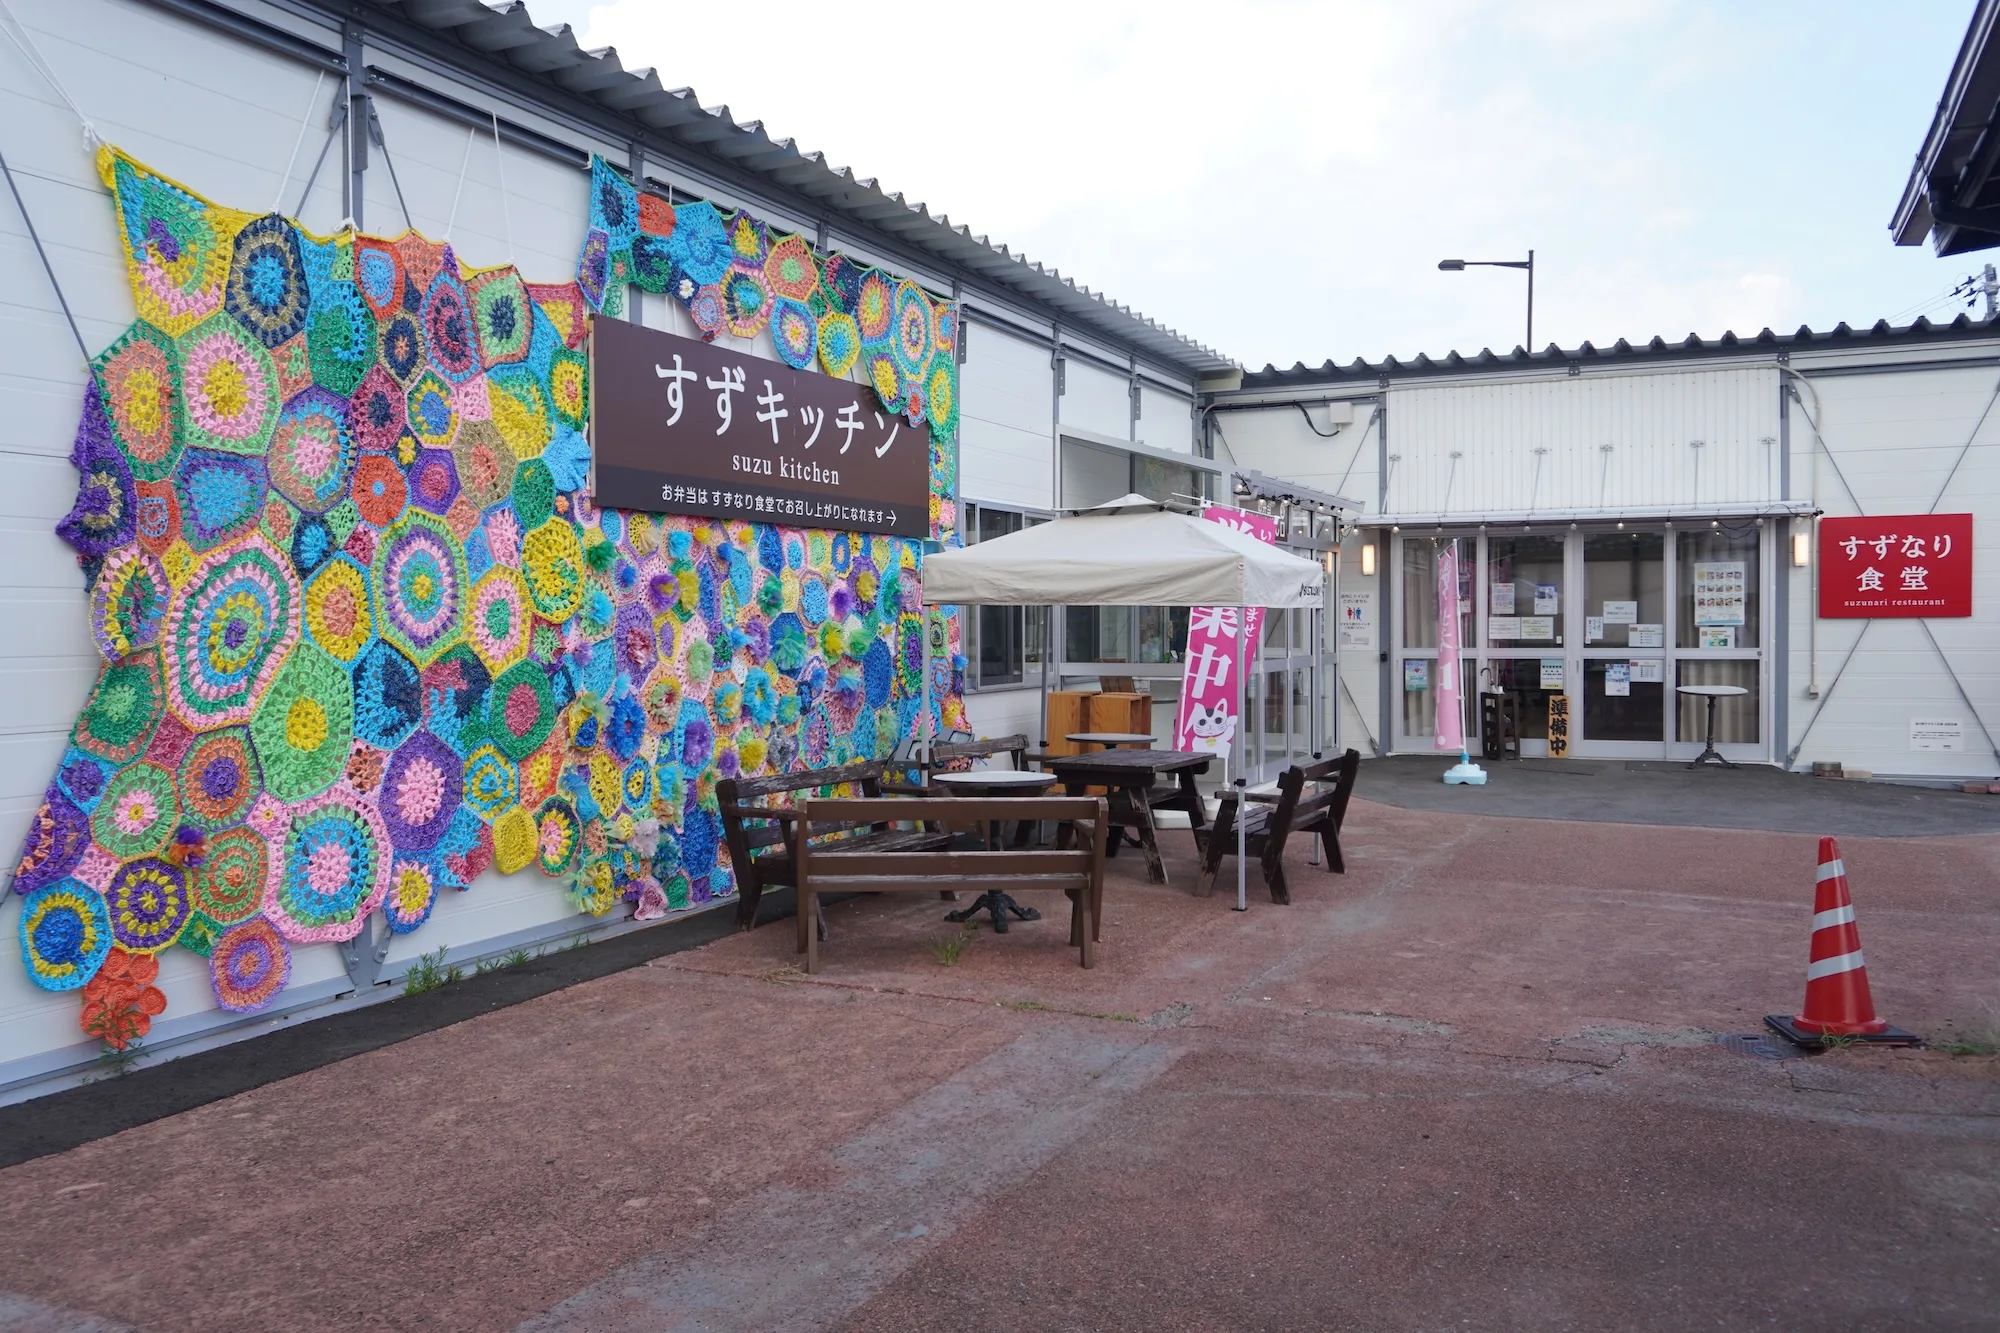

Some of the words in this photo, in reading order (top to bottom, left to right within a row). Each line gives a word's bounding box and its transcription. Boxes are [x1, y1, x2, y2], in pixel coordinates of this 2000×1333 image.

[655, 354, 899, 458] すずキッチン
[732, 454, 772, 475] suzu
[779, 456, 839, 485] kitchen
[661, 484, 708, 505] お弁当は
[712, 490, 883, 524] すずなり食堂でお召し上がりになれます
[1839, 534, 1951, 561] すずなり
[1856, 565, 1928, 592] 食堂
[1892, 598, 1945, 606] restaurant
[1549, 698, 1569, 755] 準備中
